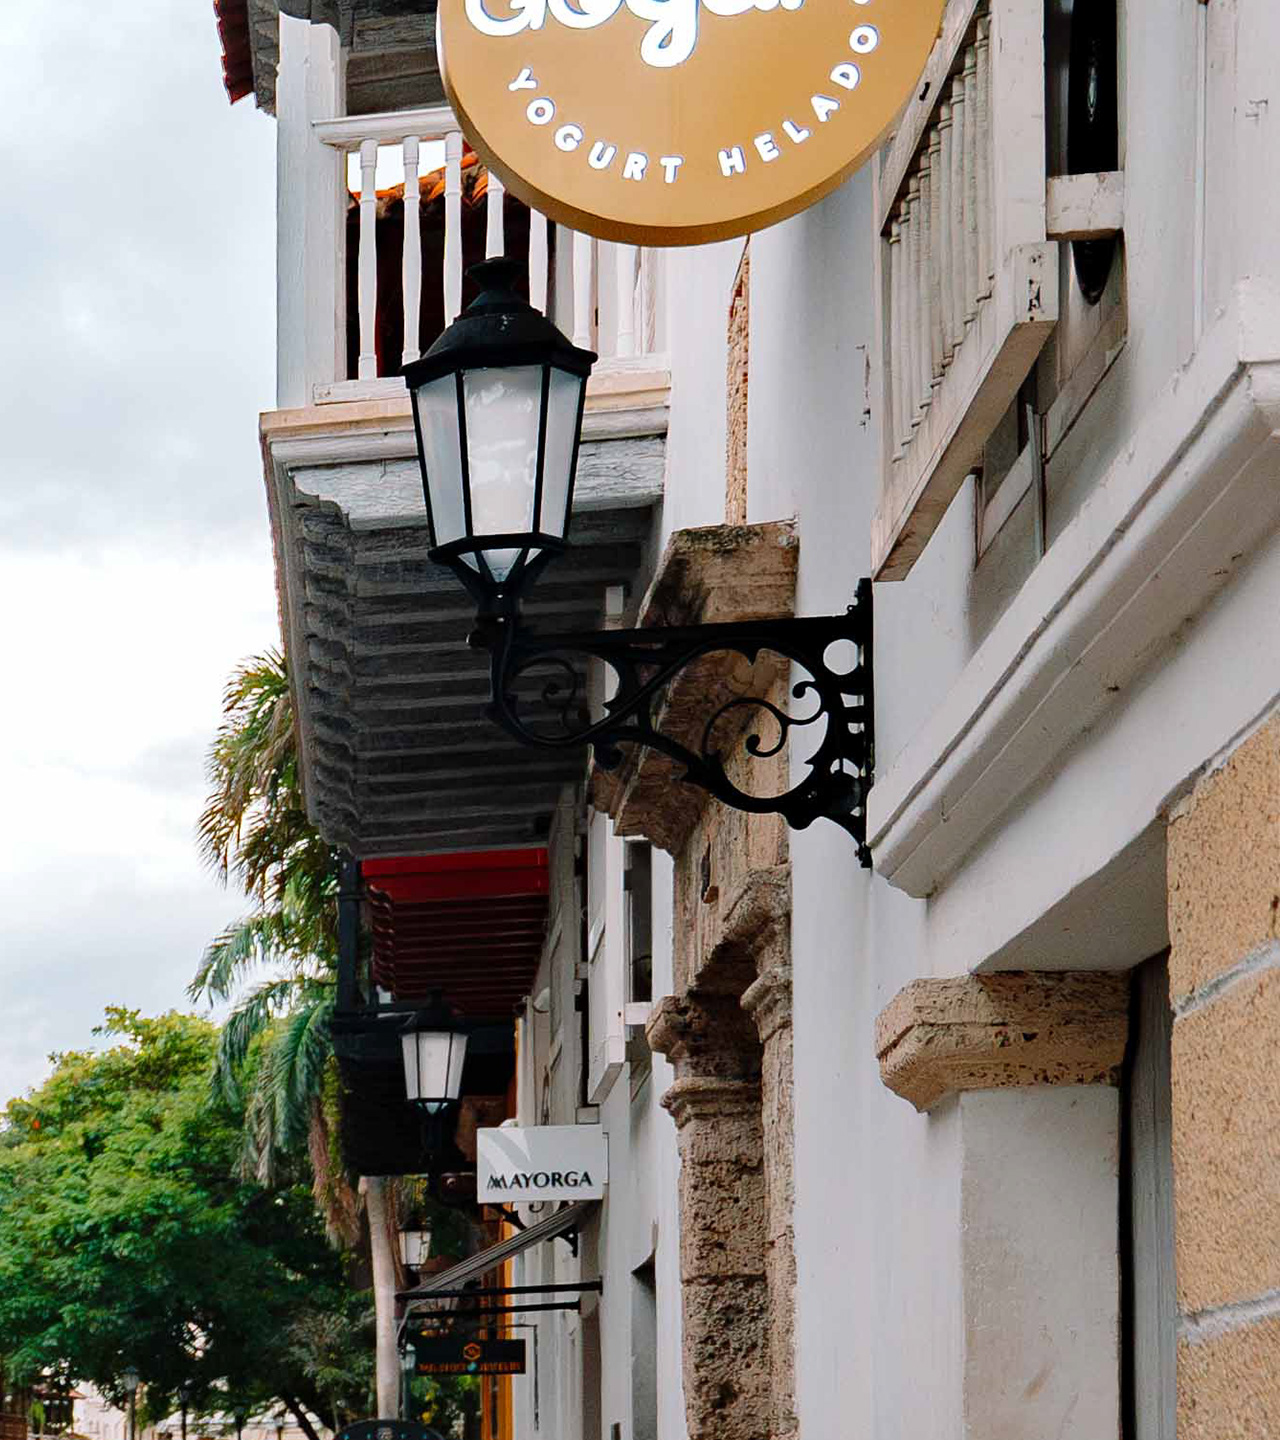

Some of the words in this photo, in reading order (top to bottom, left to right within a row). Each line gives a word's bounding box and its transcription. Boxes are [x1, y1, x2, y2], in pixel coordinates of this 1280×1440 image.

[508, 66, 684, 184] YOGURT
[717, 23, 878, 177] HELADO
[486, 1170, 593, 1190] MAYORGA
